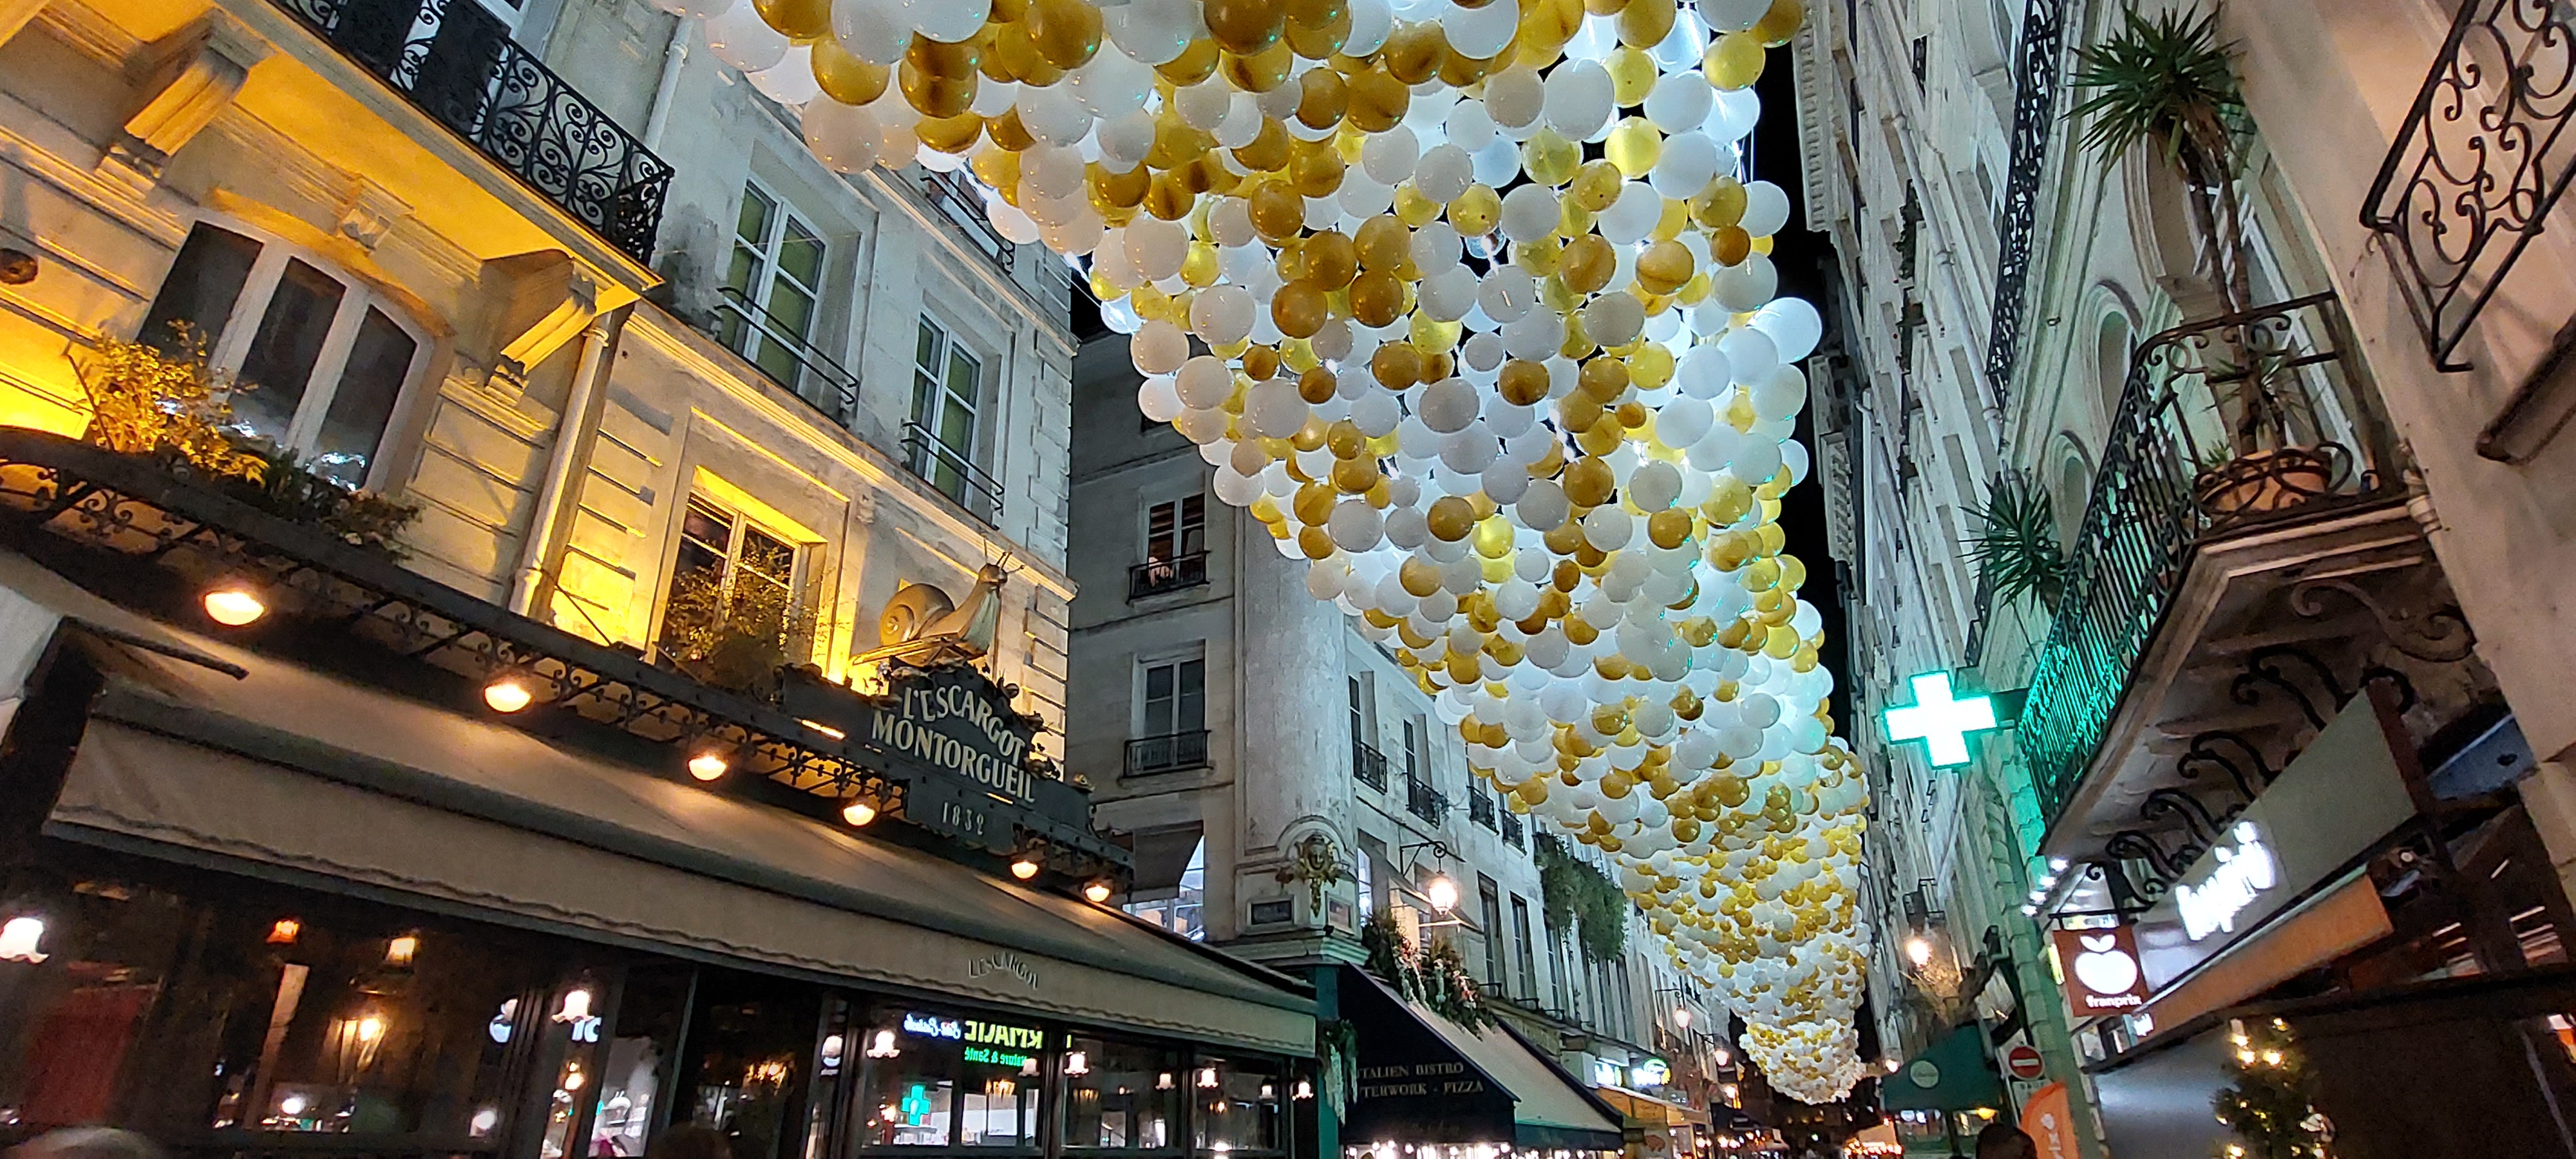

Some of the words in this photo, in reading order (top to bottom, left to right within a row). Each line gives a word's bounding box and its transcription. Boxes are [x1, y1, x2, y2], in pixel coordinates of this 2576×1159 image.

[904, 685, 1025, 766] L'ESCARGOT
[872, 710, 1035, 802] MONTORGUEIL
[943, 802, 984, 836] 1832
[2085, 992, 2143, 1008] franprix
[1416, 1062, 1464, 1075] BISTRO
[1444, 1080, 1483, 1094] PIZZA
